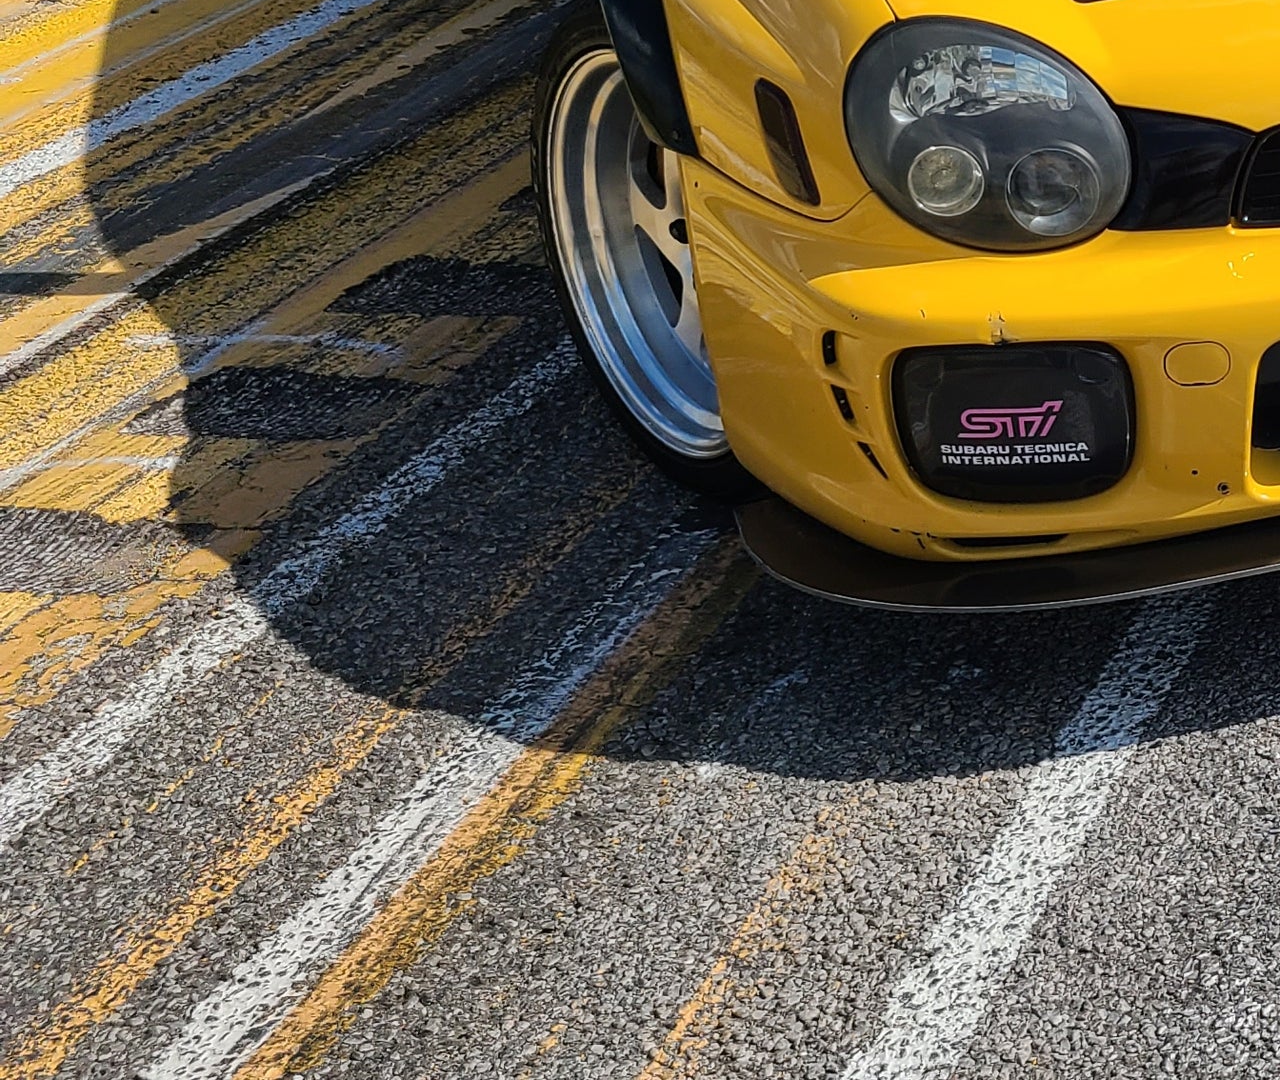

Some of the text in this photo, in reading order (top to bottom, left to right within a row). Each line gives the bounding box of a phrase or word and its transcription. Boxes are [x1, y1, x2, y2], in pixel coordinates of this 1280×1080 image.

[940, 442, 1089, 455] SUBARU TECNICA
[942, 453, 1091, 465] INTERNATIONAL
